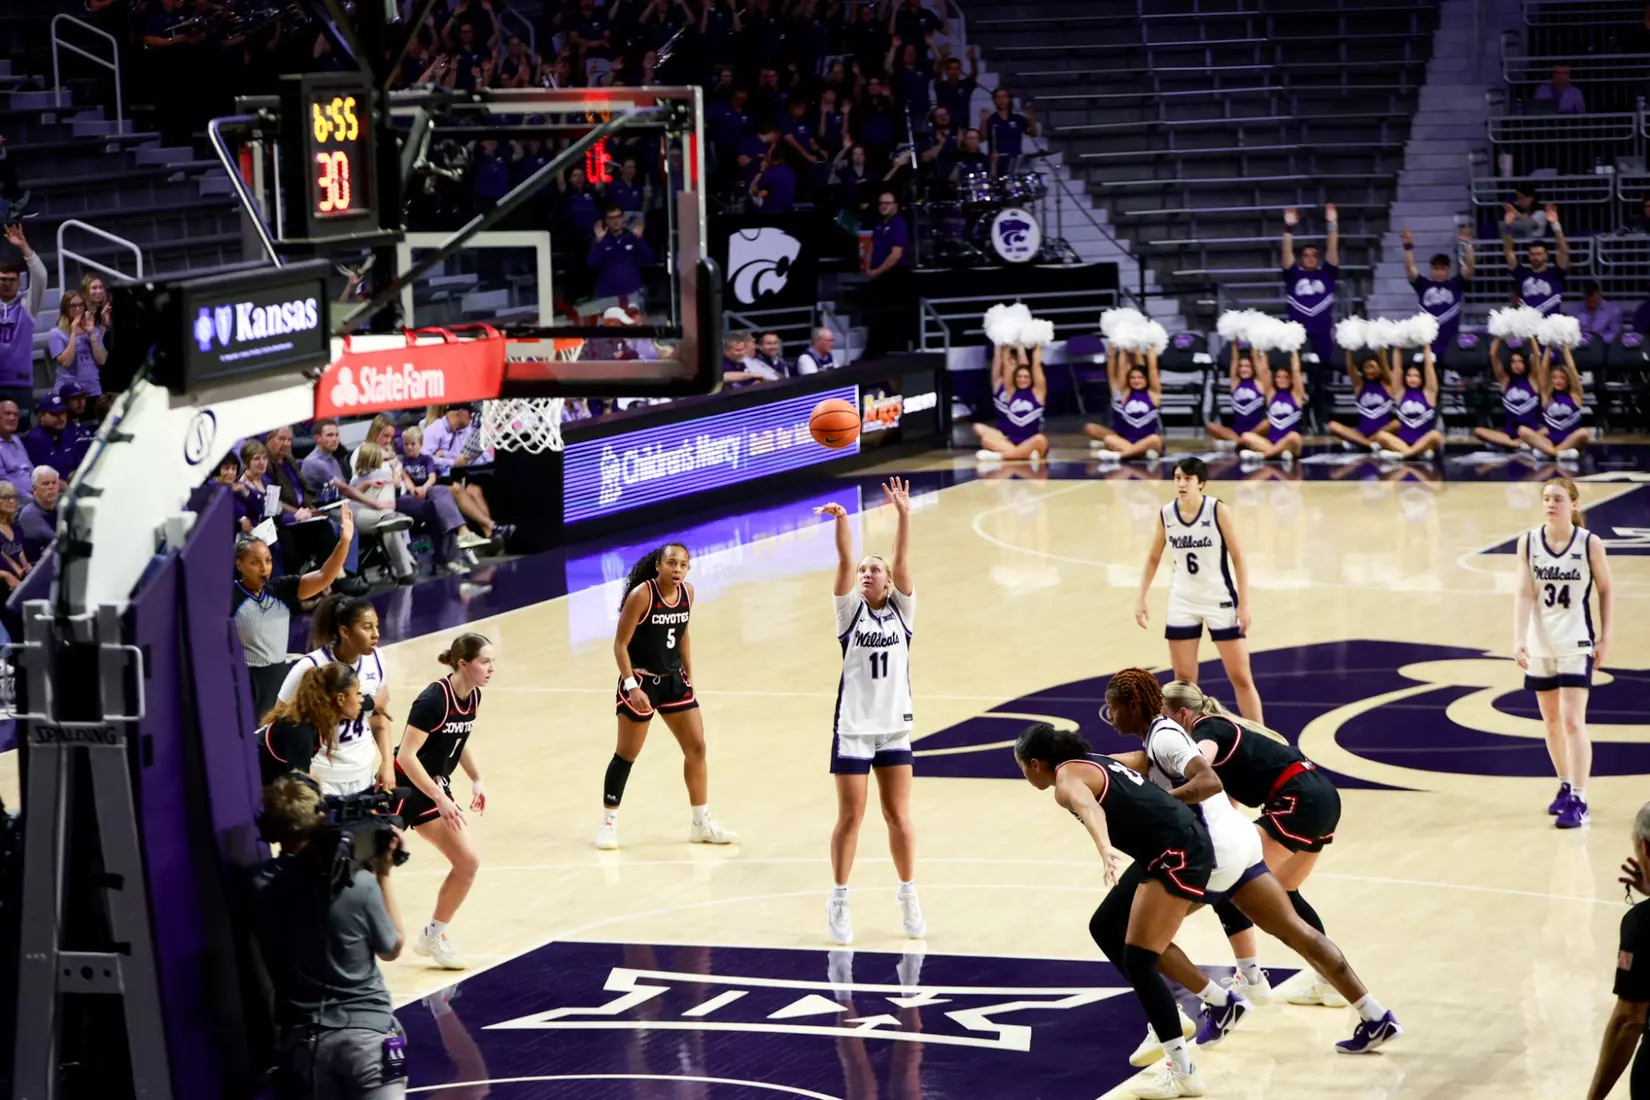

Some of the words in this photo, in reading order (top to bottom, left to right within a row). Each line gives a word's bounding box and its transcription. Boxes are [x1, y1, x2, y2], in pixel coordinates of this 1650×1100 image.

[312, 96, 359, 143] 6:55
[316, 151, 351, 212] 30
[235, 297, 318, 342] Kansas
[1169, 534, 1213, 550] Wildcats
[1186, 551, 1199, 575] 6
[1533, 565, 1582, 581] Wildcats
[1544, 583, 1571, 609] 34
[666, 628, 676, 649] 5
[855, 630, 900, 648] Wildcats
[869, 651, 889, 680] 11
[338, 711, 364, 744] 24
[448, 738, 462, 758] 1
